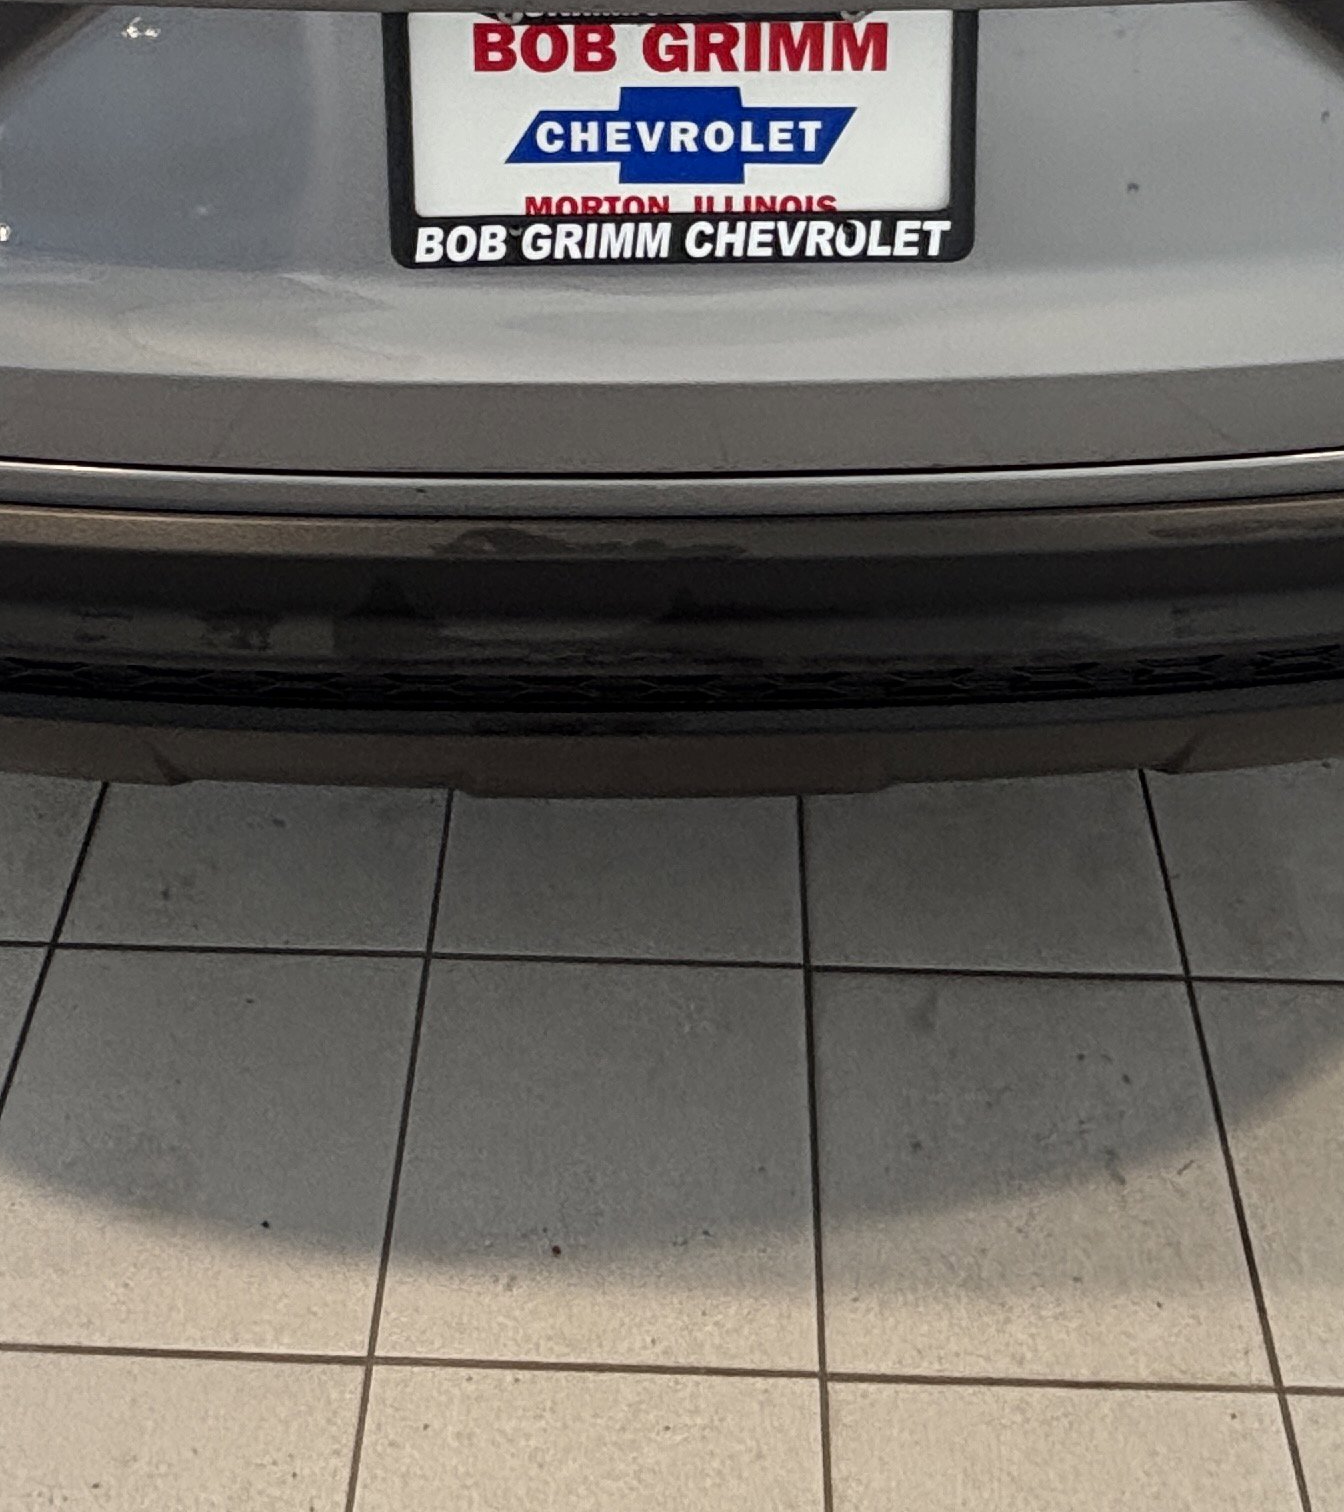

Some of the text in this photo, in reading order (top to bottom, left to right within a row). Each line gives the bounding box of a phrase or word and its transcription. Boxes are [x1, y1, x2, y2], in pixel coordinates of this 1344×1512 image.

[473, 22, 888, 72] BOB GRIMM
[535, 120, 823, 153] CHEVROLET
[524, 196, 670, 216] MORTON
[414, 219, 952, 263] BOB GRIMM CHEVROLET
